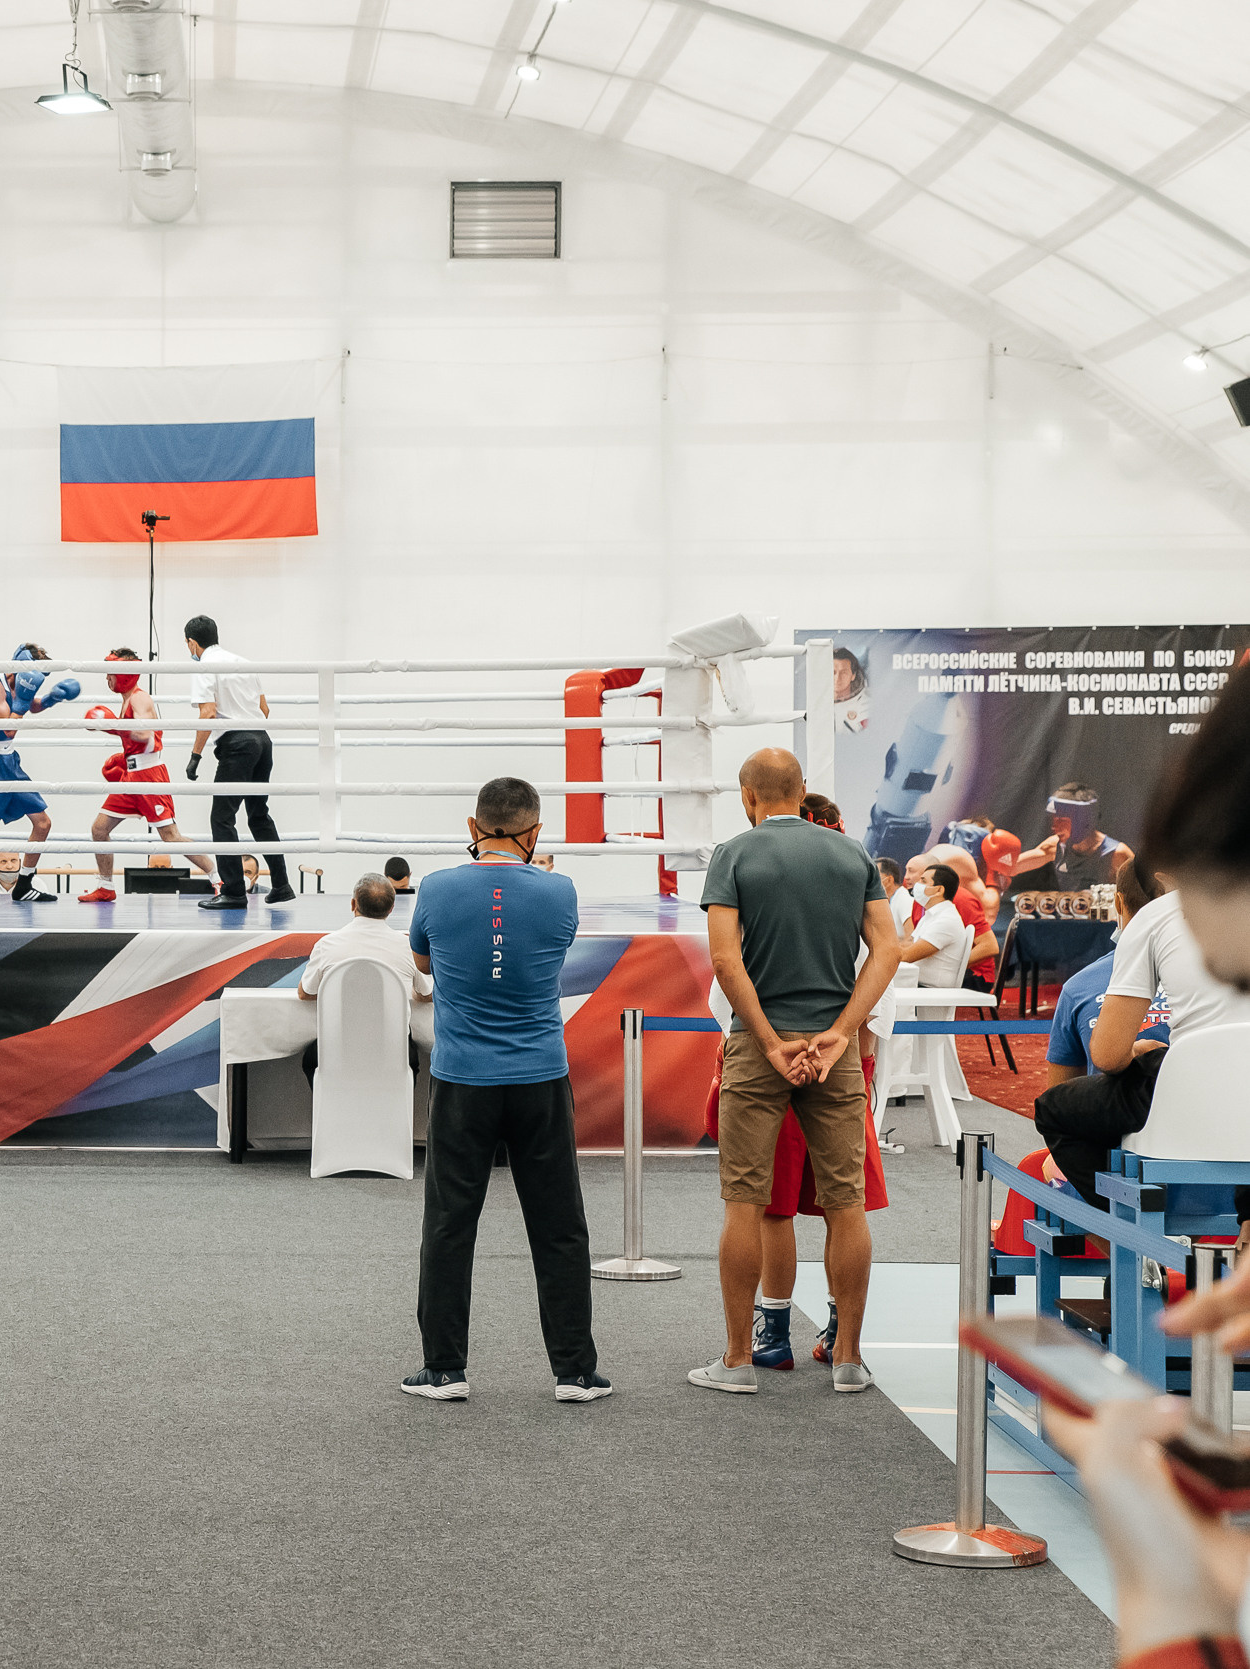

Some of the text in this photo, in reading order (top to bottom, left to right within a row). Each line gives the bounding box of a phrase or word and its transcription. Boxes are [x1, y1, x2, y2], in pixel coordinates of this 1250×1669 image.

[892, 649, 1236, 669] ВСЕРОССИЙСКИЕ СОРЕВНОВАНИЯ ПО БОКСУ
[918, 675, 985, 693] ПАМЯТИ
[987, 672, 1181, 693] ЛЁТЧИКА-КОСМОНАВТА
[1068, 696, 1100, 716] В.И.
[492, 888, 503, 979] RUSSIA
